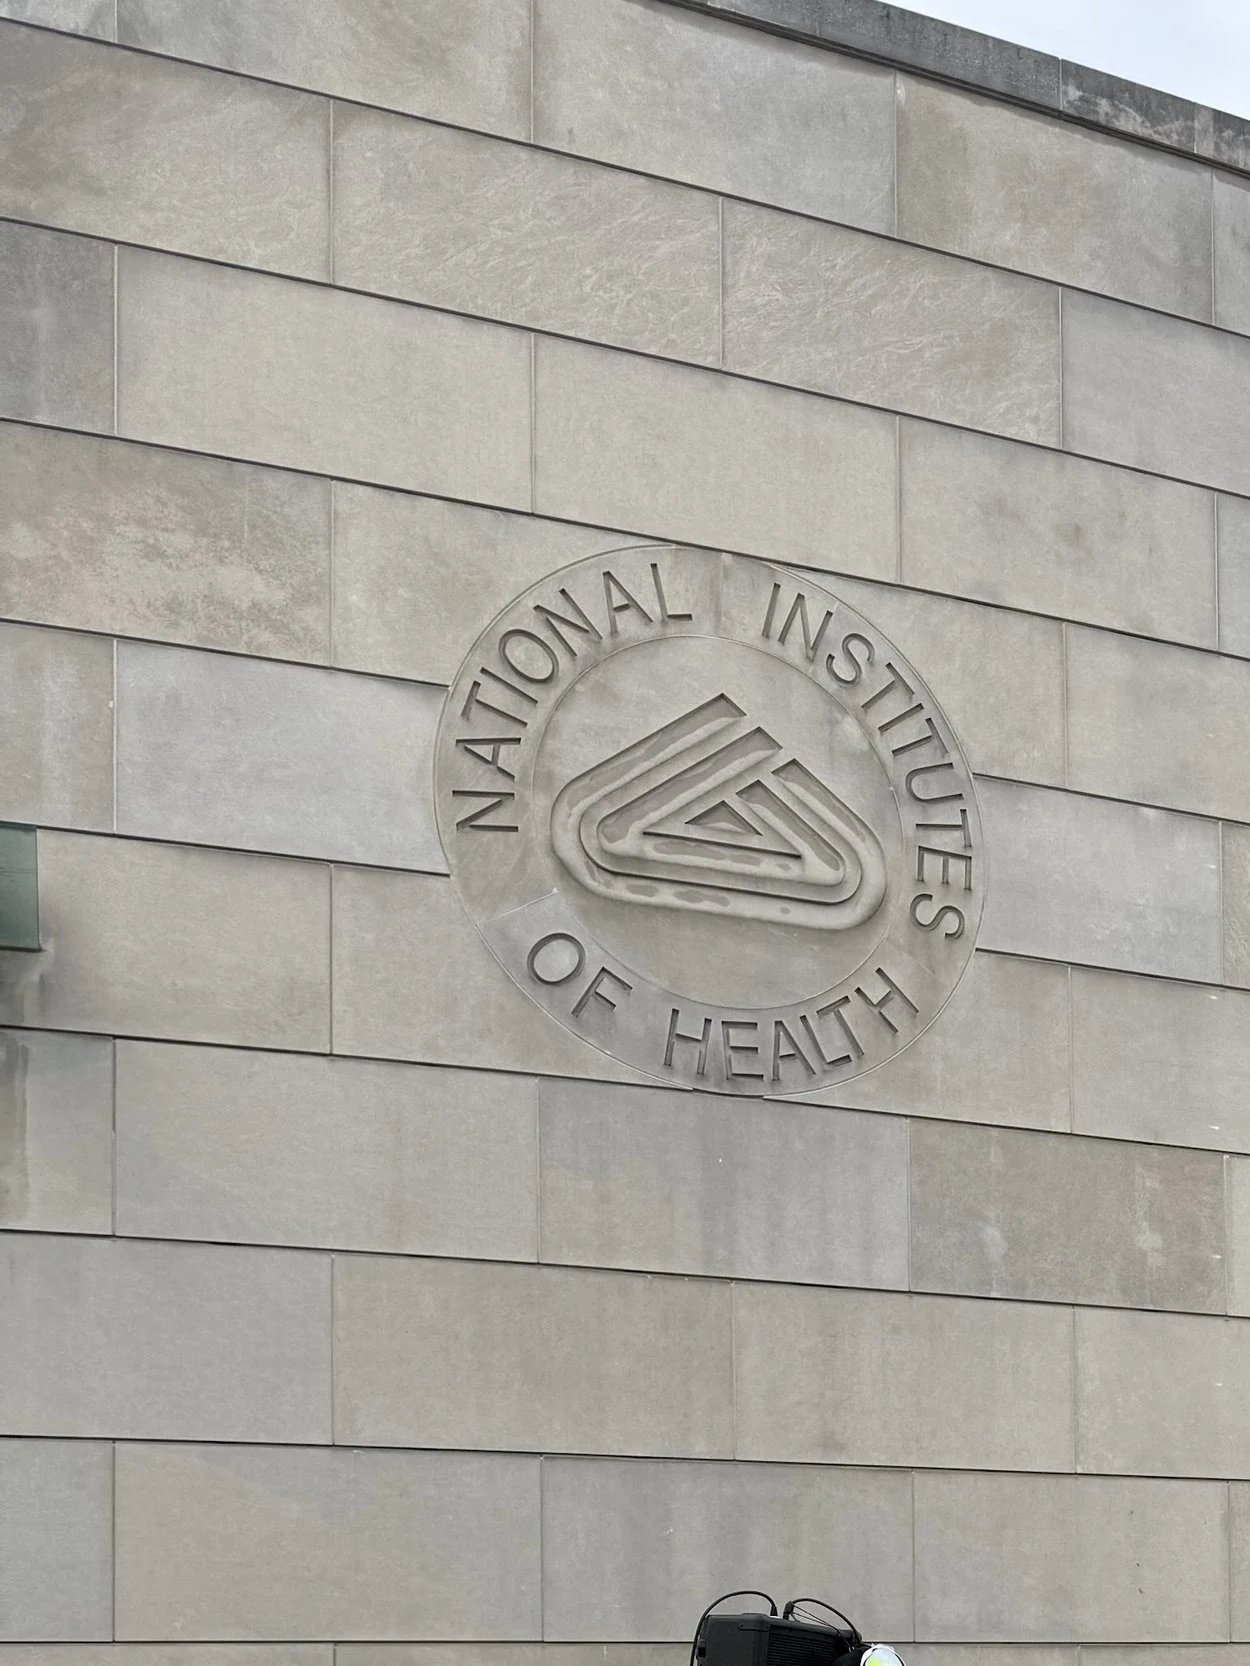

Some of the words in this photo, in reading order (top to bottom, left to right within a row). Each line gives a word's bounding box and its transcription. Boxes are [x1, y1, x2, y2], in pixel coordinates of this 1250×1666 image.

[451, 561, 694, 833] NATIONAL
[761, 581, 974, 942] INSTITUTES
[526, 931, 634, 1019] OF
[663, 965, 920, 1081] HEALTH
